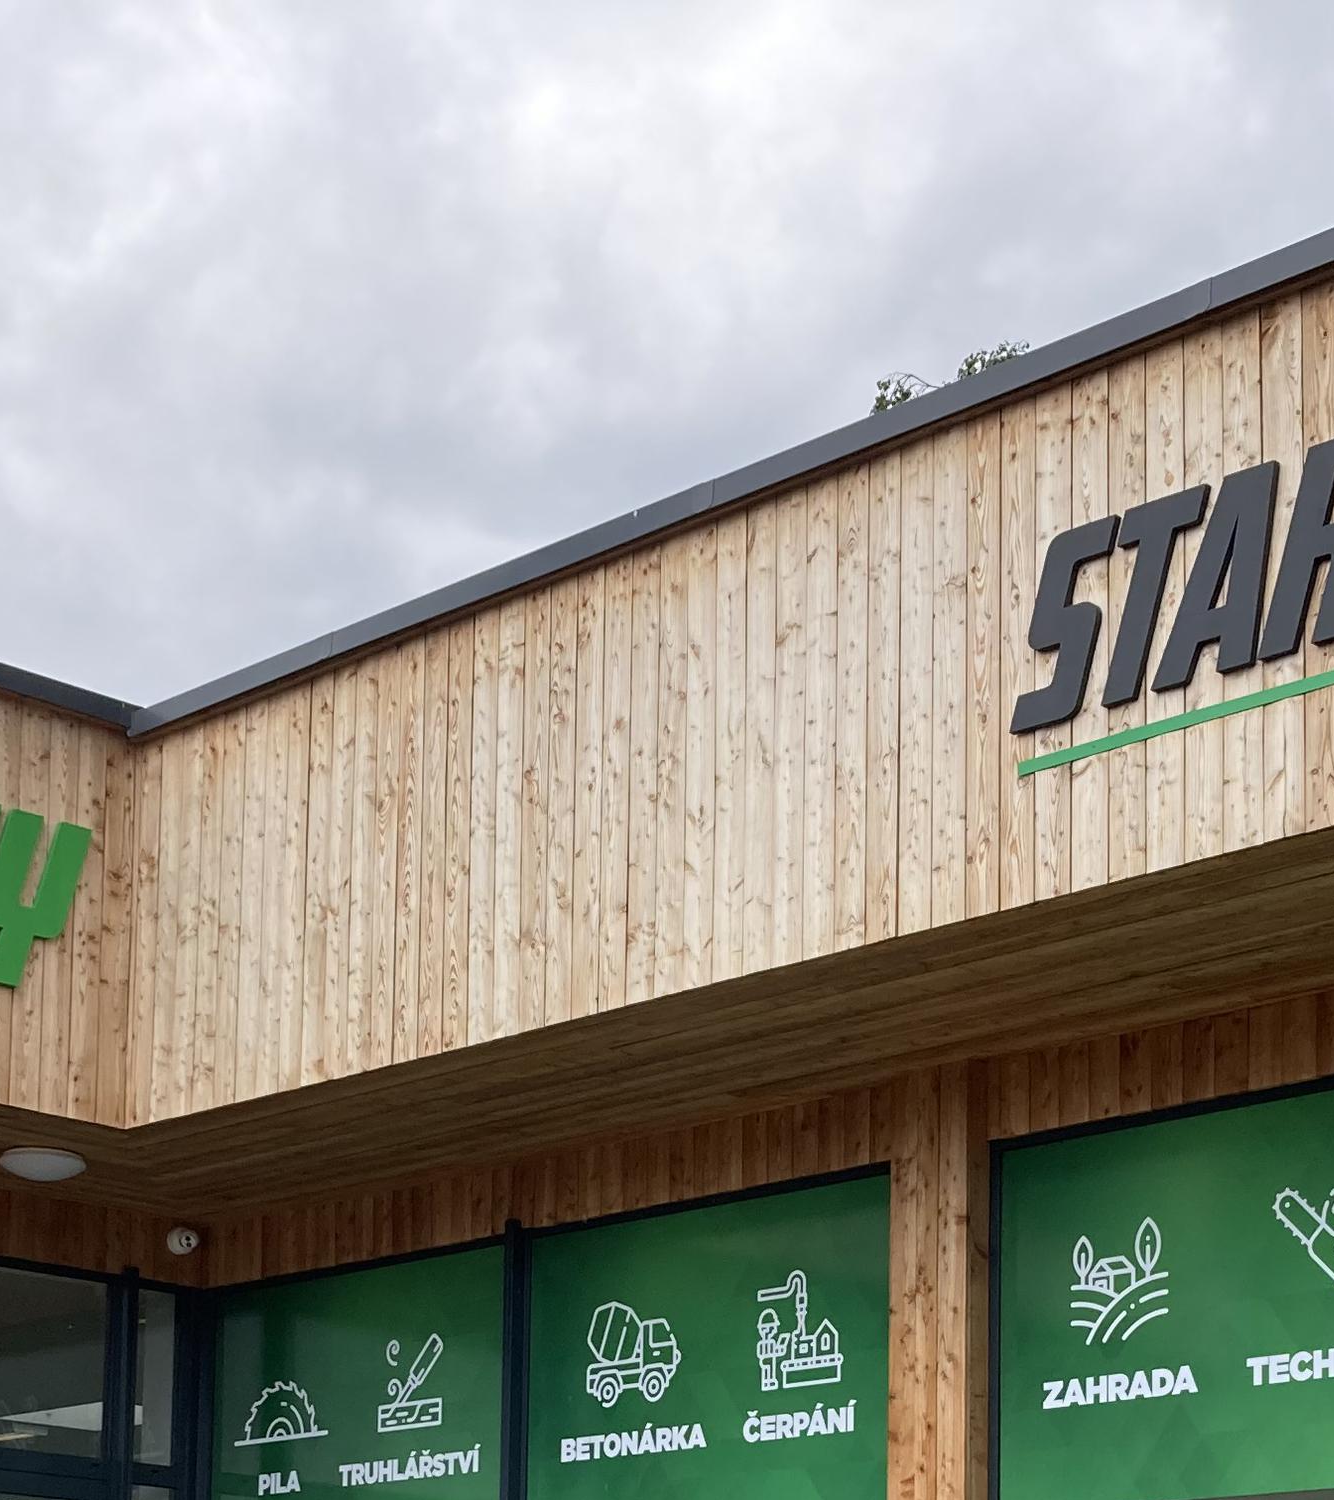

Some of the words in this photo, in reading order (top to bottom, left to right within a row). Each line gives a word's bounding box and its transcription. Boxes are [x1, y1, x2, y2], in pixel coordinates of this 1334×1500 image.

[1042, 1366, 1199, 1410] ZAHRADA
[560, 1423, 707, 1464] BETONÁRKA
[743, 1400, 856, 1445] ČERPÁNÍ
[257, 1470, 301, 1496] PILA
[339, 1443, 480, 1488] TRUHLÁŘSTVÍ
